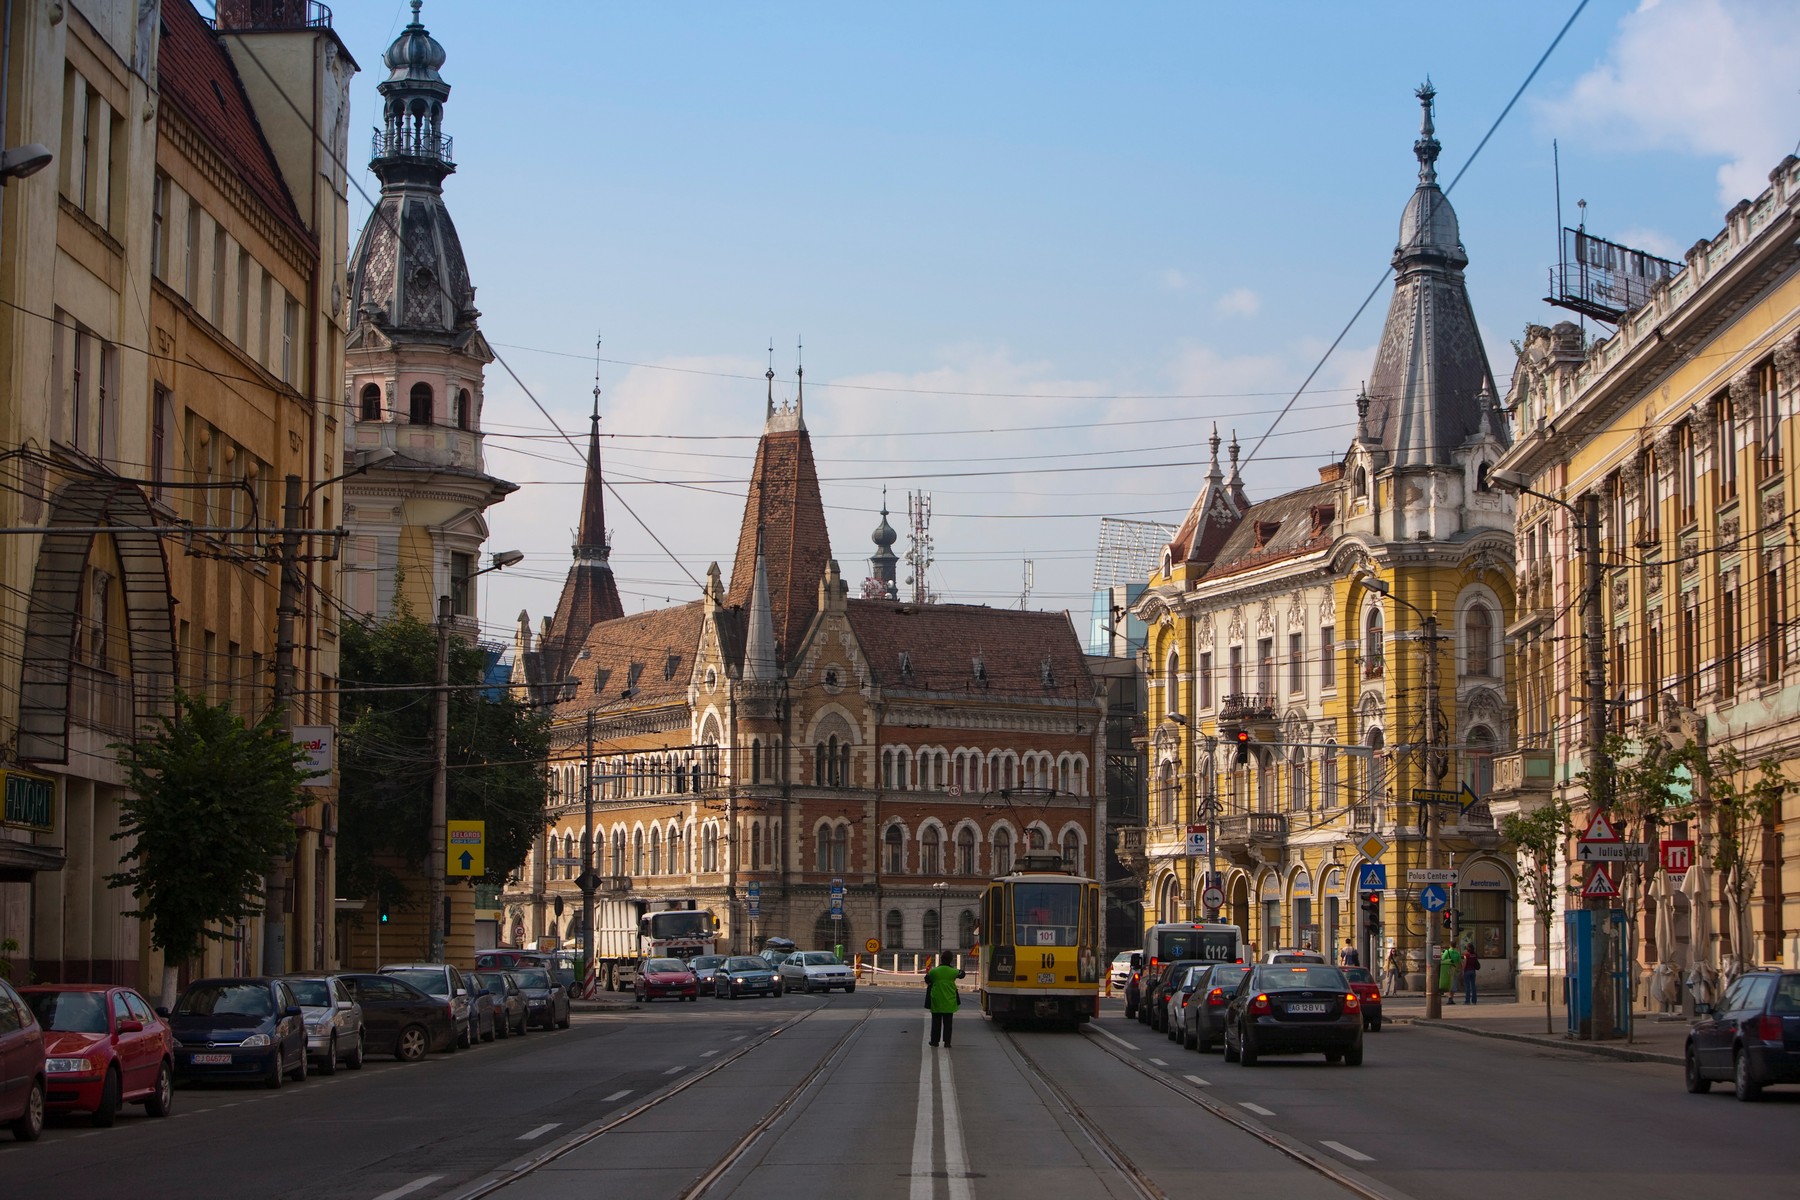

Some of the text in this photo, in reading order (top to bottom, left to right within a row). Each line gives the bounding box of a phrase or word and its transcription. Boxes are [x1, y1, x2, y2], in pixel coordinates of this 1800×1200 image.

[6, 777, 53, 825] FAVORIT
[1414, 791, 1457, 802] METRO
[1598, 846, 1624, 857] Iulius
[1408, 871, 1449, 880] Polus Center
[1470, 879, 1501, 887] Aerotravel
[1040, 931, 1054, 941] 101
[1210, 945, 1228, 960] 112
[1041, 952, 1055, 969] 10
